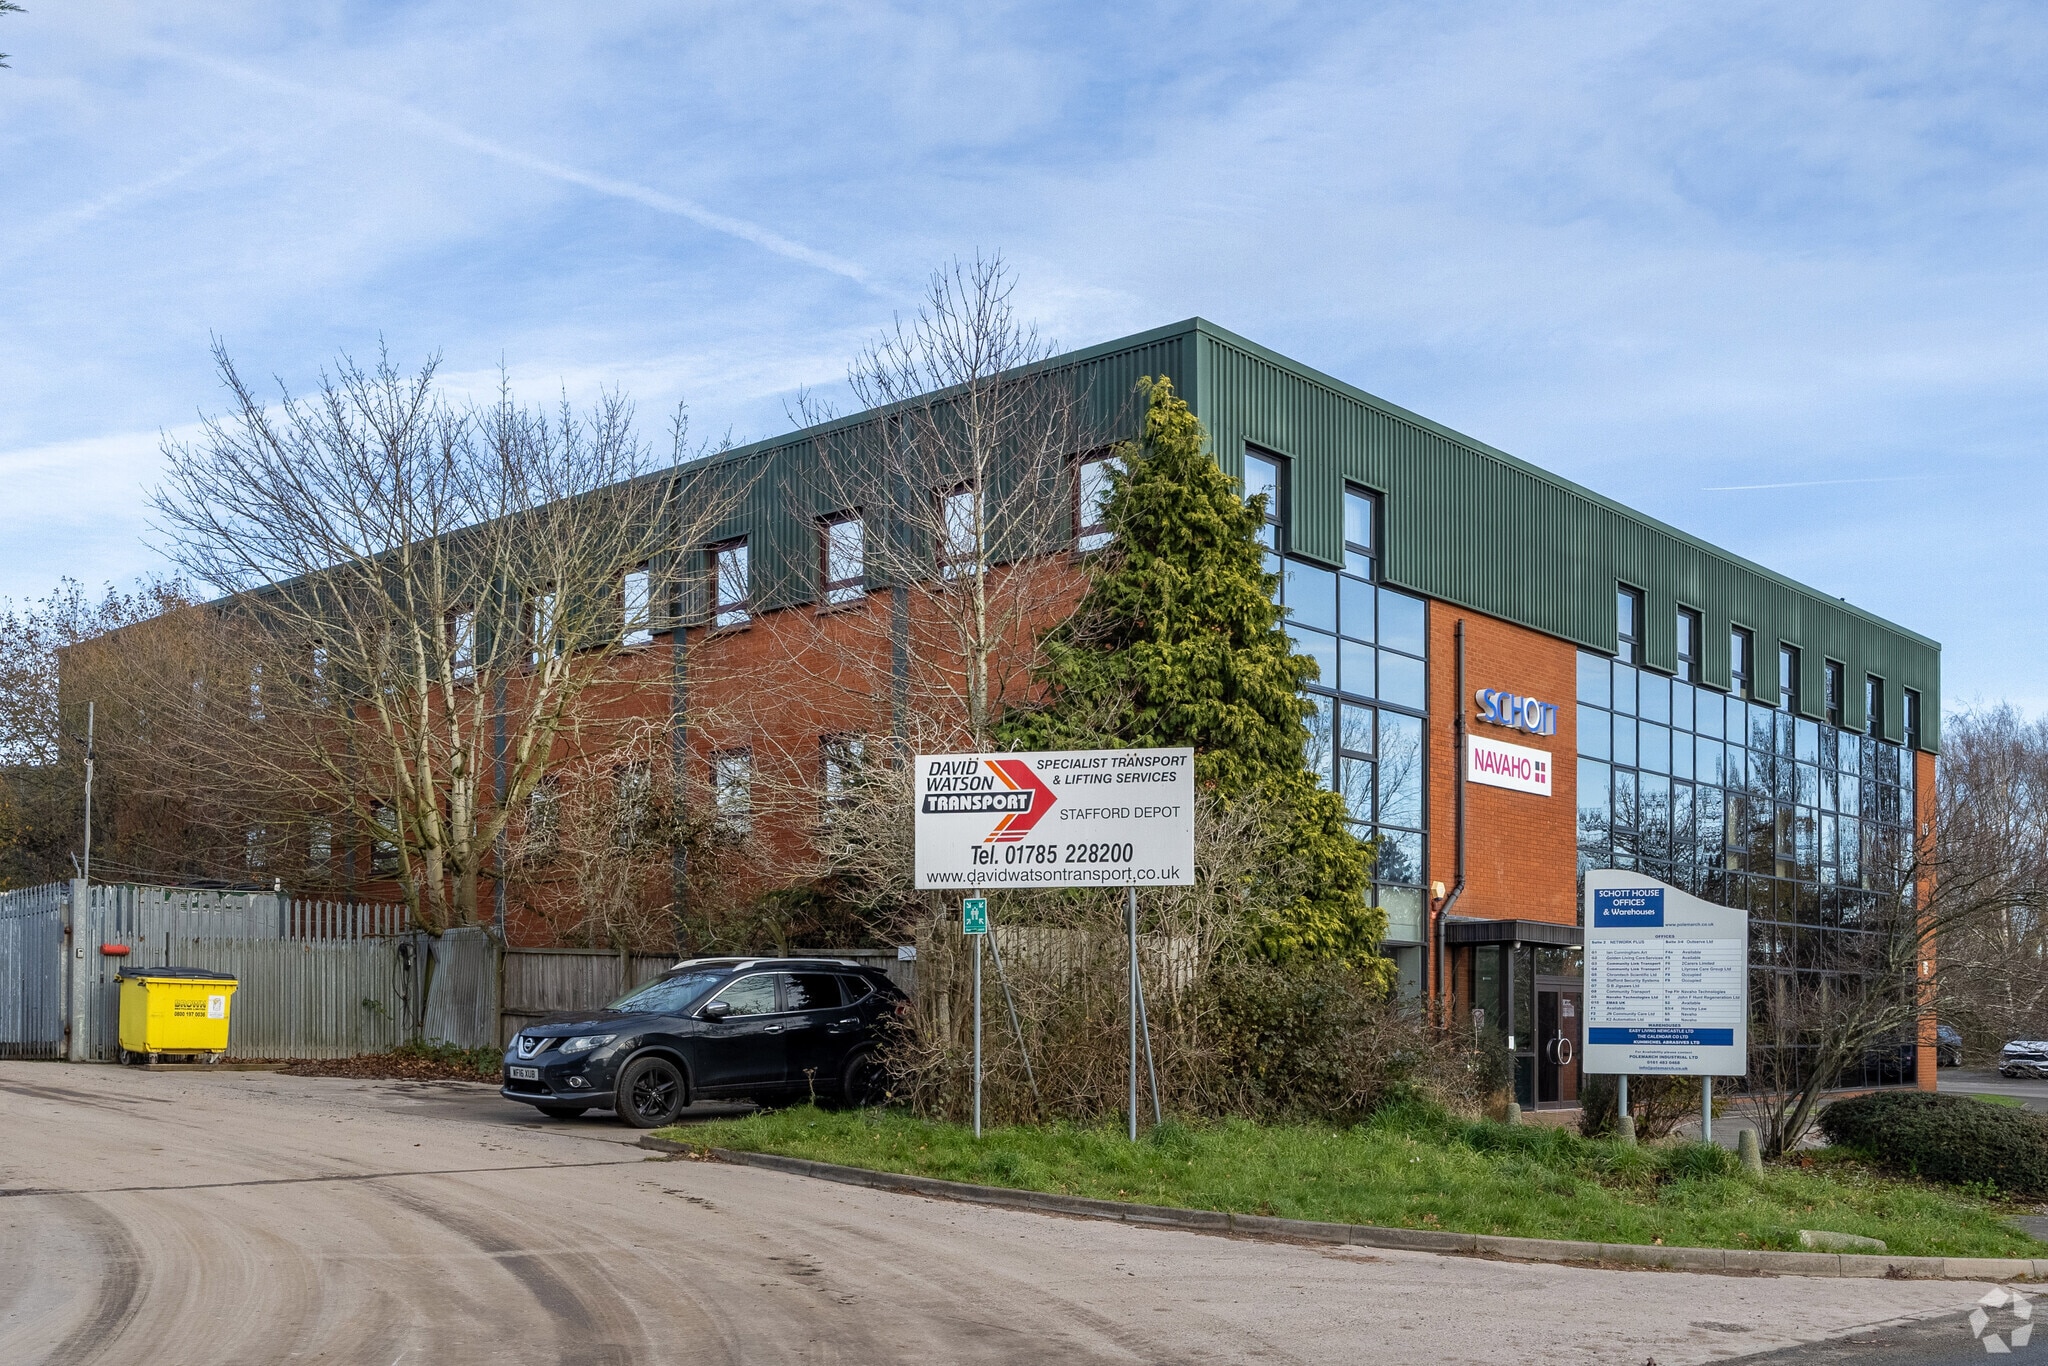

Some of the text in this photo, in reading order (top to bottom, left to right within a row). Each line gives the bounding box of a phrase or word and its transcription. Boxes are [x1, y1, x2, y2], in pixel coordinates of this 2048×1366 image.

[1476, 688, 1559, 736] SCHOTT
[928, 761, 978, 776] DAVID
[1036, 755, 1188, 771] SPECIALIST TRANSPORT
[1475, 748, 1531, 780] NAVAHO
[926, 776, 994, 791] WATSON
[1052, 771, 1177, 786] & LIFTING SERVICES
[927, 794, 1028, 812] TRANSPORT
[1060, 806, 1180, 820] STAFFORD DEPOT
[970, 843, 1133, 865] Tel. 01785 228200
[926, 866, 1180, 883] www.davidwatsontransport.co.uk
[1632, 889, 1660, 897] HOUSE
